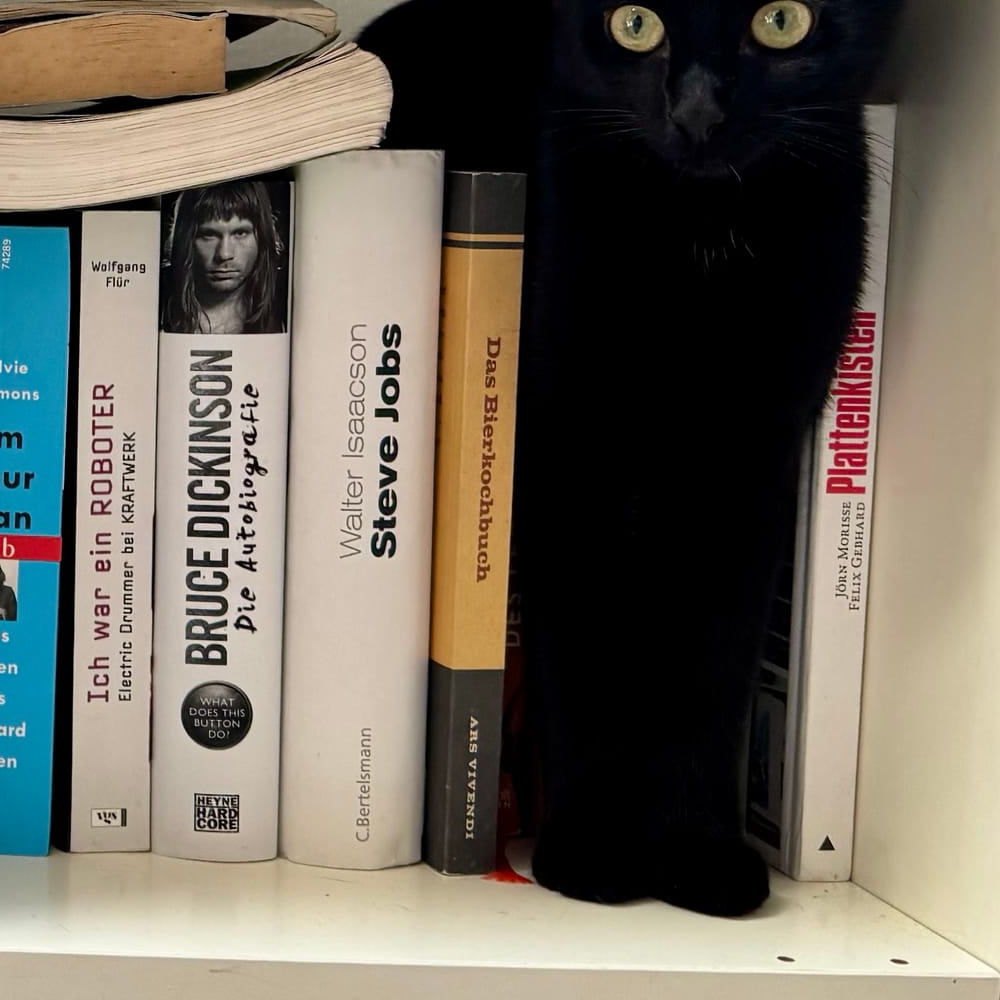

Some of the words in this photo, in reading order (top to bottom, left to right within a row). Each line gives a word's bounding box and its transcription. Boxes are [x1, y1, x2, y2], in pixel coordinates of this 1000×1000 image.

[1, 238, 12, 270] 74289
[91, 259, 147, 276] Wolfgang
[105, 274, 130, 289] Flür
[373, 323, 402, 423] Jobs
[483, 336, 502, 388] Das
[340, 323, 367, 460] Isaacson
[826, 312, 876, 495] Plattenkisten
[90, 384, 115, 516] ROBOTER
[187, 349, 233, 539] DICKINSON
[121, 431, 136, 524] KRAFTWERK
[234, 383, 270, 574] Autobiografie
[369, 435, 399, 560] Steve
[475, 393, 500, 583] Bierkochbuch
[339, 469, 365, 559] Walter
[89, 531, 112, 573] ein
[120, 531, 135, 555] bei
[92, 587, 111, 641] war
[119, 561, 134, 634] Drummer
[184, 547, 229, 667] BRUCE
[233, 586, 257, 635] Die
[87, 656, 110, 704] Ich
[118, 641, 133, 703] Electric
[188, 707, 219, 718] DOES
[222, 708, 246, 718] THIS
[193, 718, 241, 728] BUTTON
[199, 696, 235, 707] WHAT
[208, 729, 231, 739] DO?
[467, 715, 480, 754] ARS
[196, 795, 238, 807] HEYNE
[354, 727, 373, 844] C.Bertelsmann
[464, 758, 478, 841] VIVENDI
[196, 807, 238, 819] HARD
[196, 818, 238, 831] CORE
